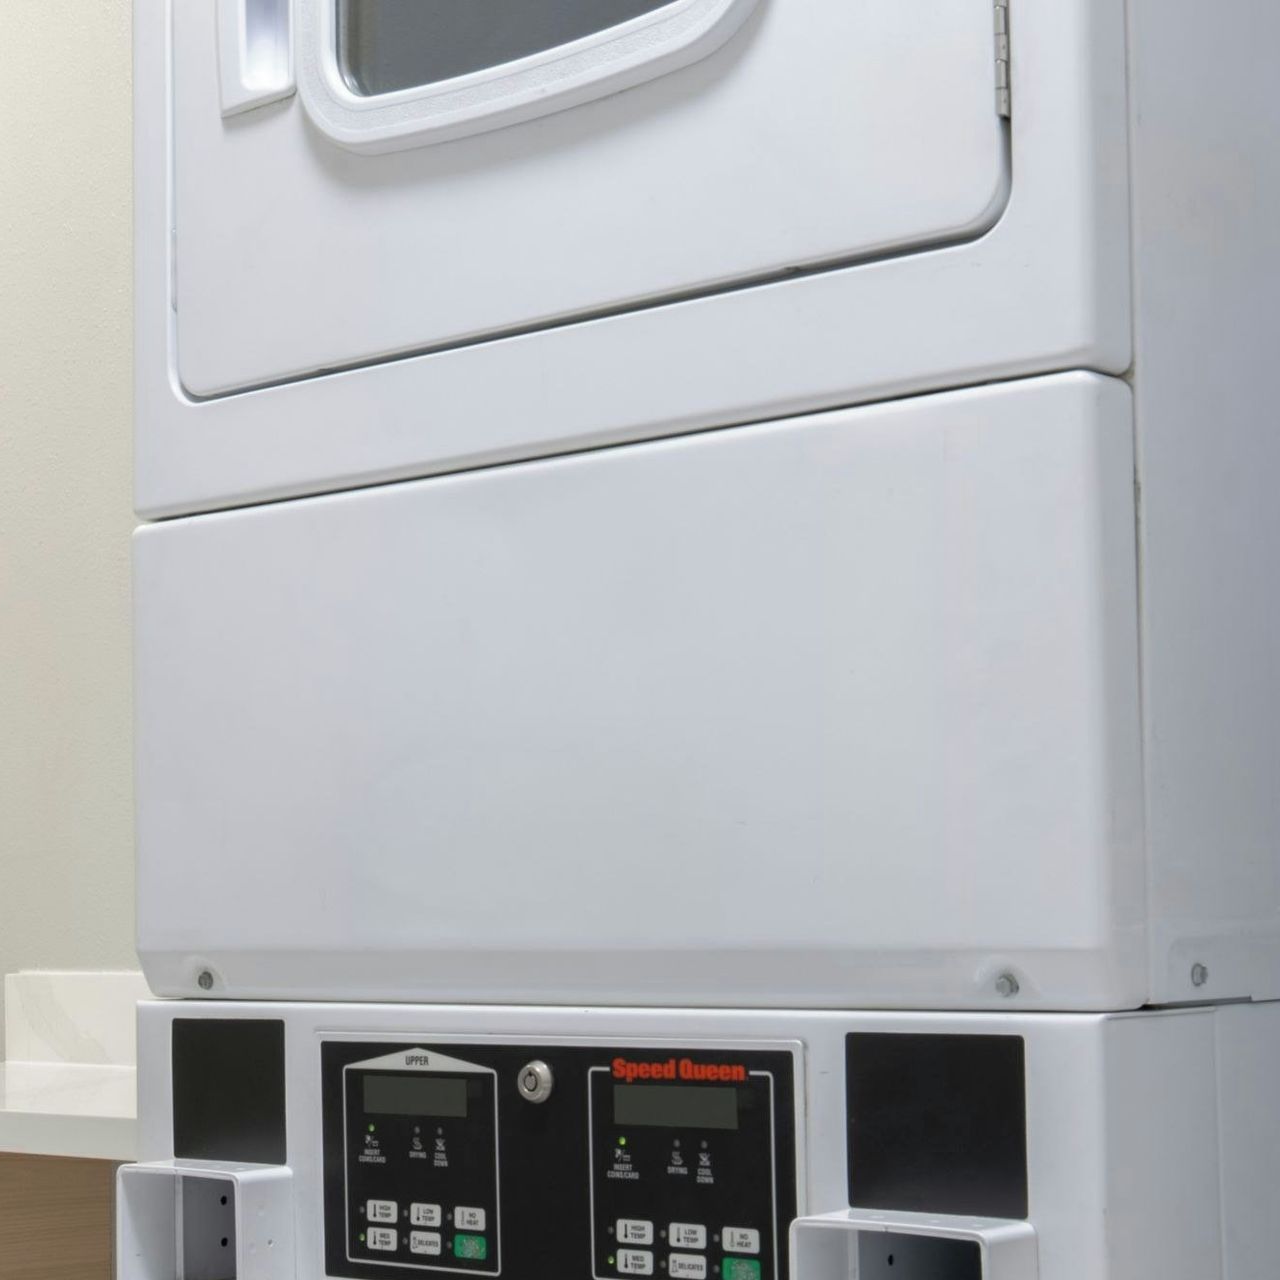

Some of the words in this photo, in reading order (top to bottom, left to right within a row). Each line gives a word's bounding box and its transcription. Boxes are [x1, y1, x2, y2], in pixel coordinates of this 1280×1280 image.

[405, 1055, 429, 1066] UPPER
[612, 1057, 676, 1083] Speed
[680, 1058, 745, 1082] Queen
[631, 1232, 646, 1240] TEMP
[683, 1236, 699, 1244] TEMP
[736, 1241, 752, 1249] HEAT
[678, 1262, 704, 1272] DELICATES
